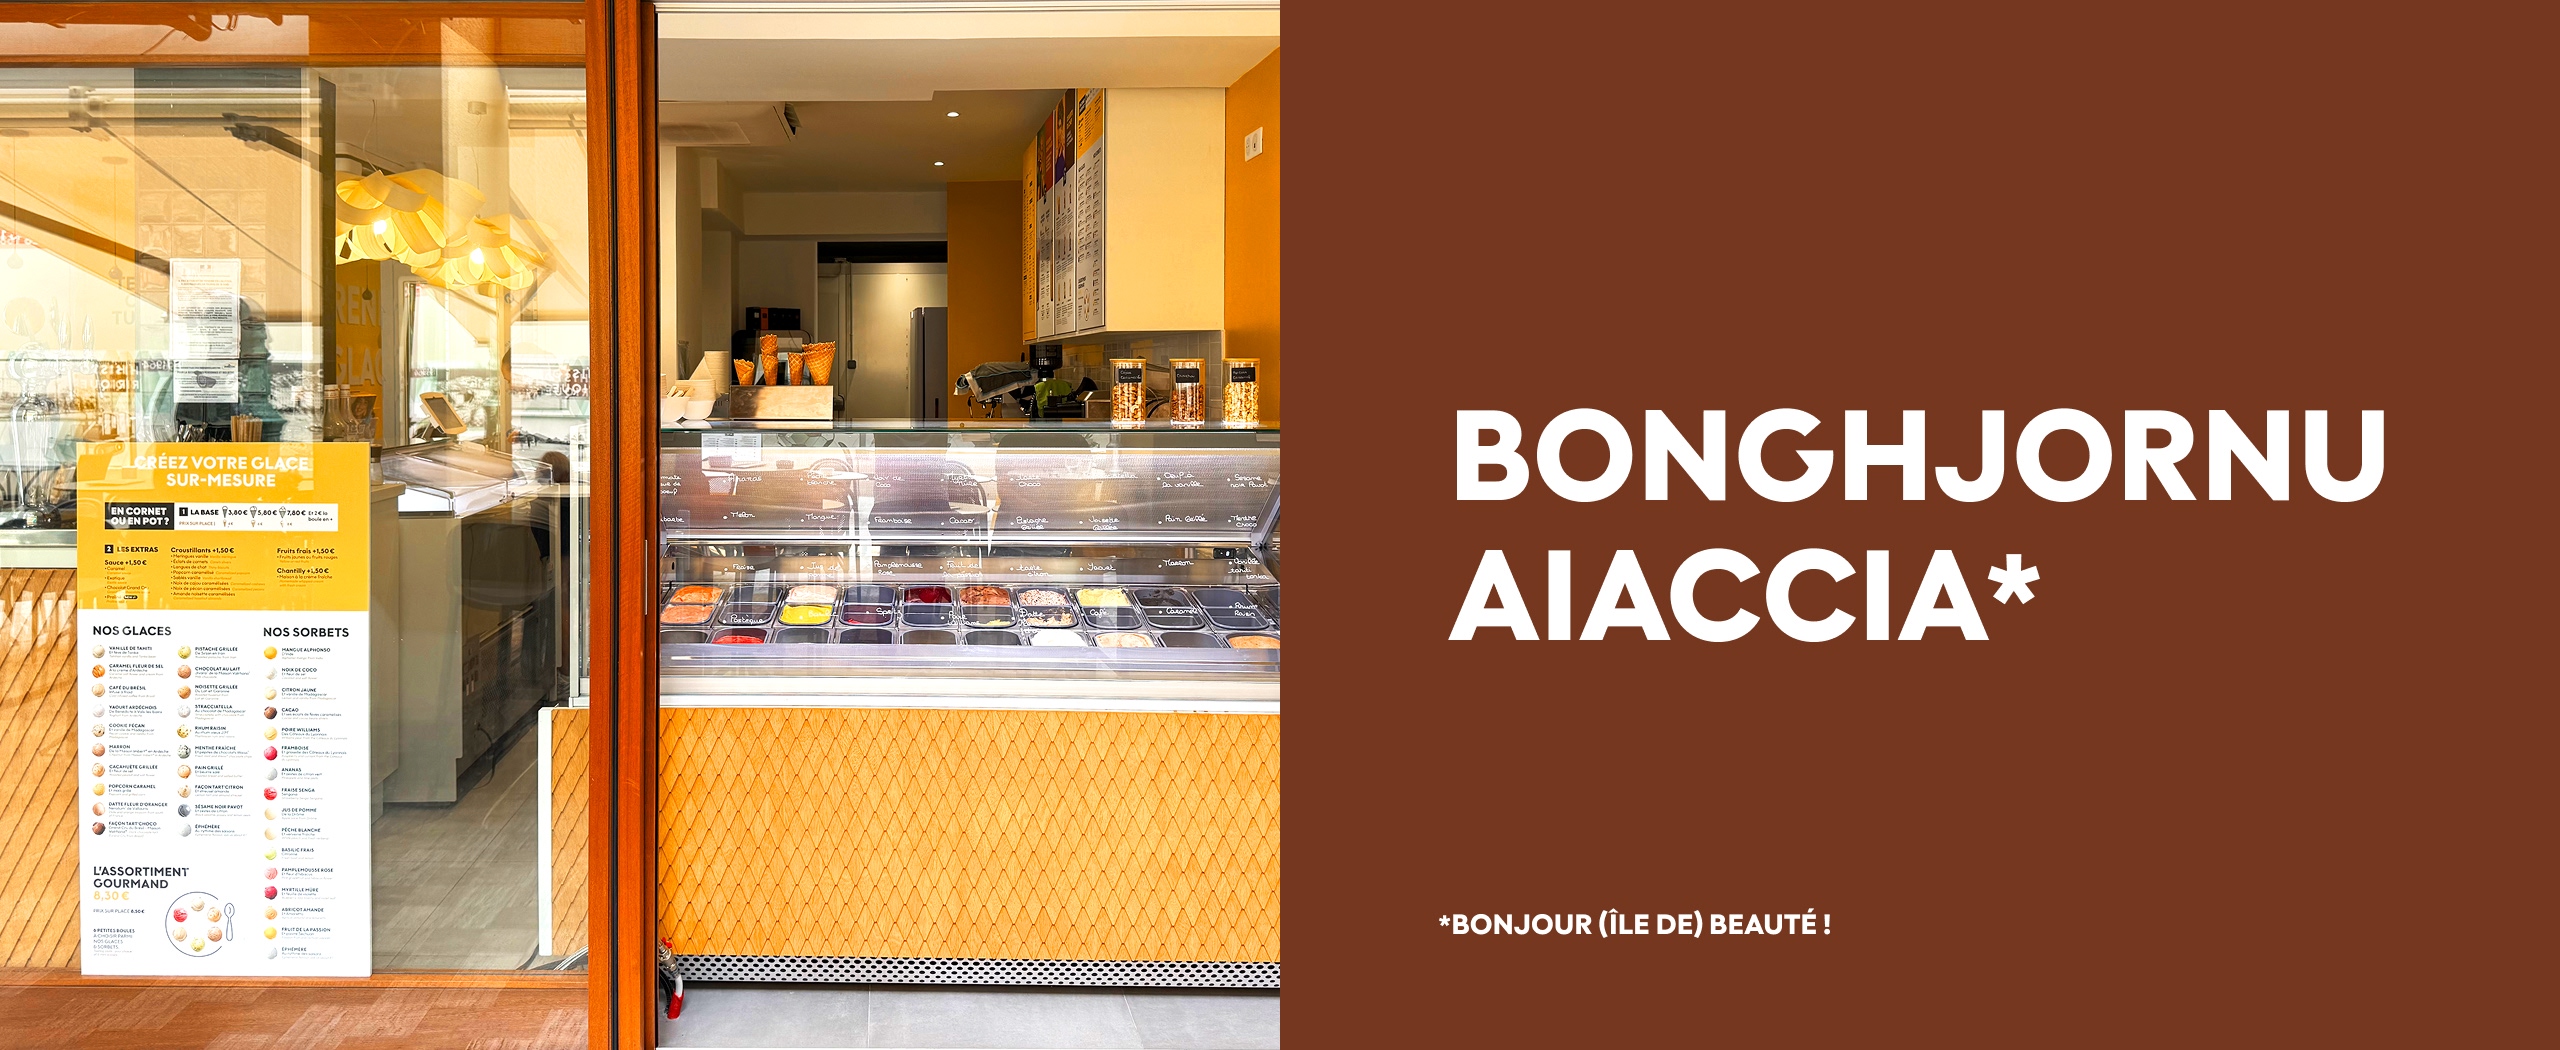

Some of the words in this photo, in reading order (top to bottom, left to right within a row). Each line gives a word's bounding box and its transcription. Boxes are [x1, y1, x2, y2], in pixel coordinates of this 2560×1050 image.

[133, 454, 188, 470] CRÉEZ
[191, 456, 247, 470] VOTRE
[251, 457, 309, 470] GLACE
[166, 473, 275, 487] SUR-MESURE
[110, 507, 125, 516] EN
[126, 507, 167, 516] CORNET
[110, 517, 126, 525] OU
[127, 517, 141, 525] EN
[93, 626, 119, 636] NOS
[122, 626, 172, 636] GLACES
[263, 627, 290, 637] NOS
[292, 627, 349, 637] SORBETS
[93, 866, 189, 877] L'ASSORTIMENT
[93, 878, 169, 888] GOURMAND
[93, 891, 119, 901] 8,30
